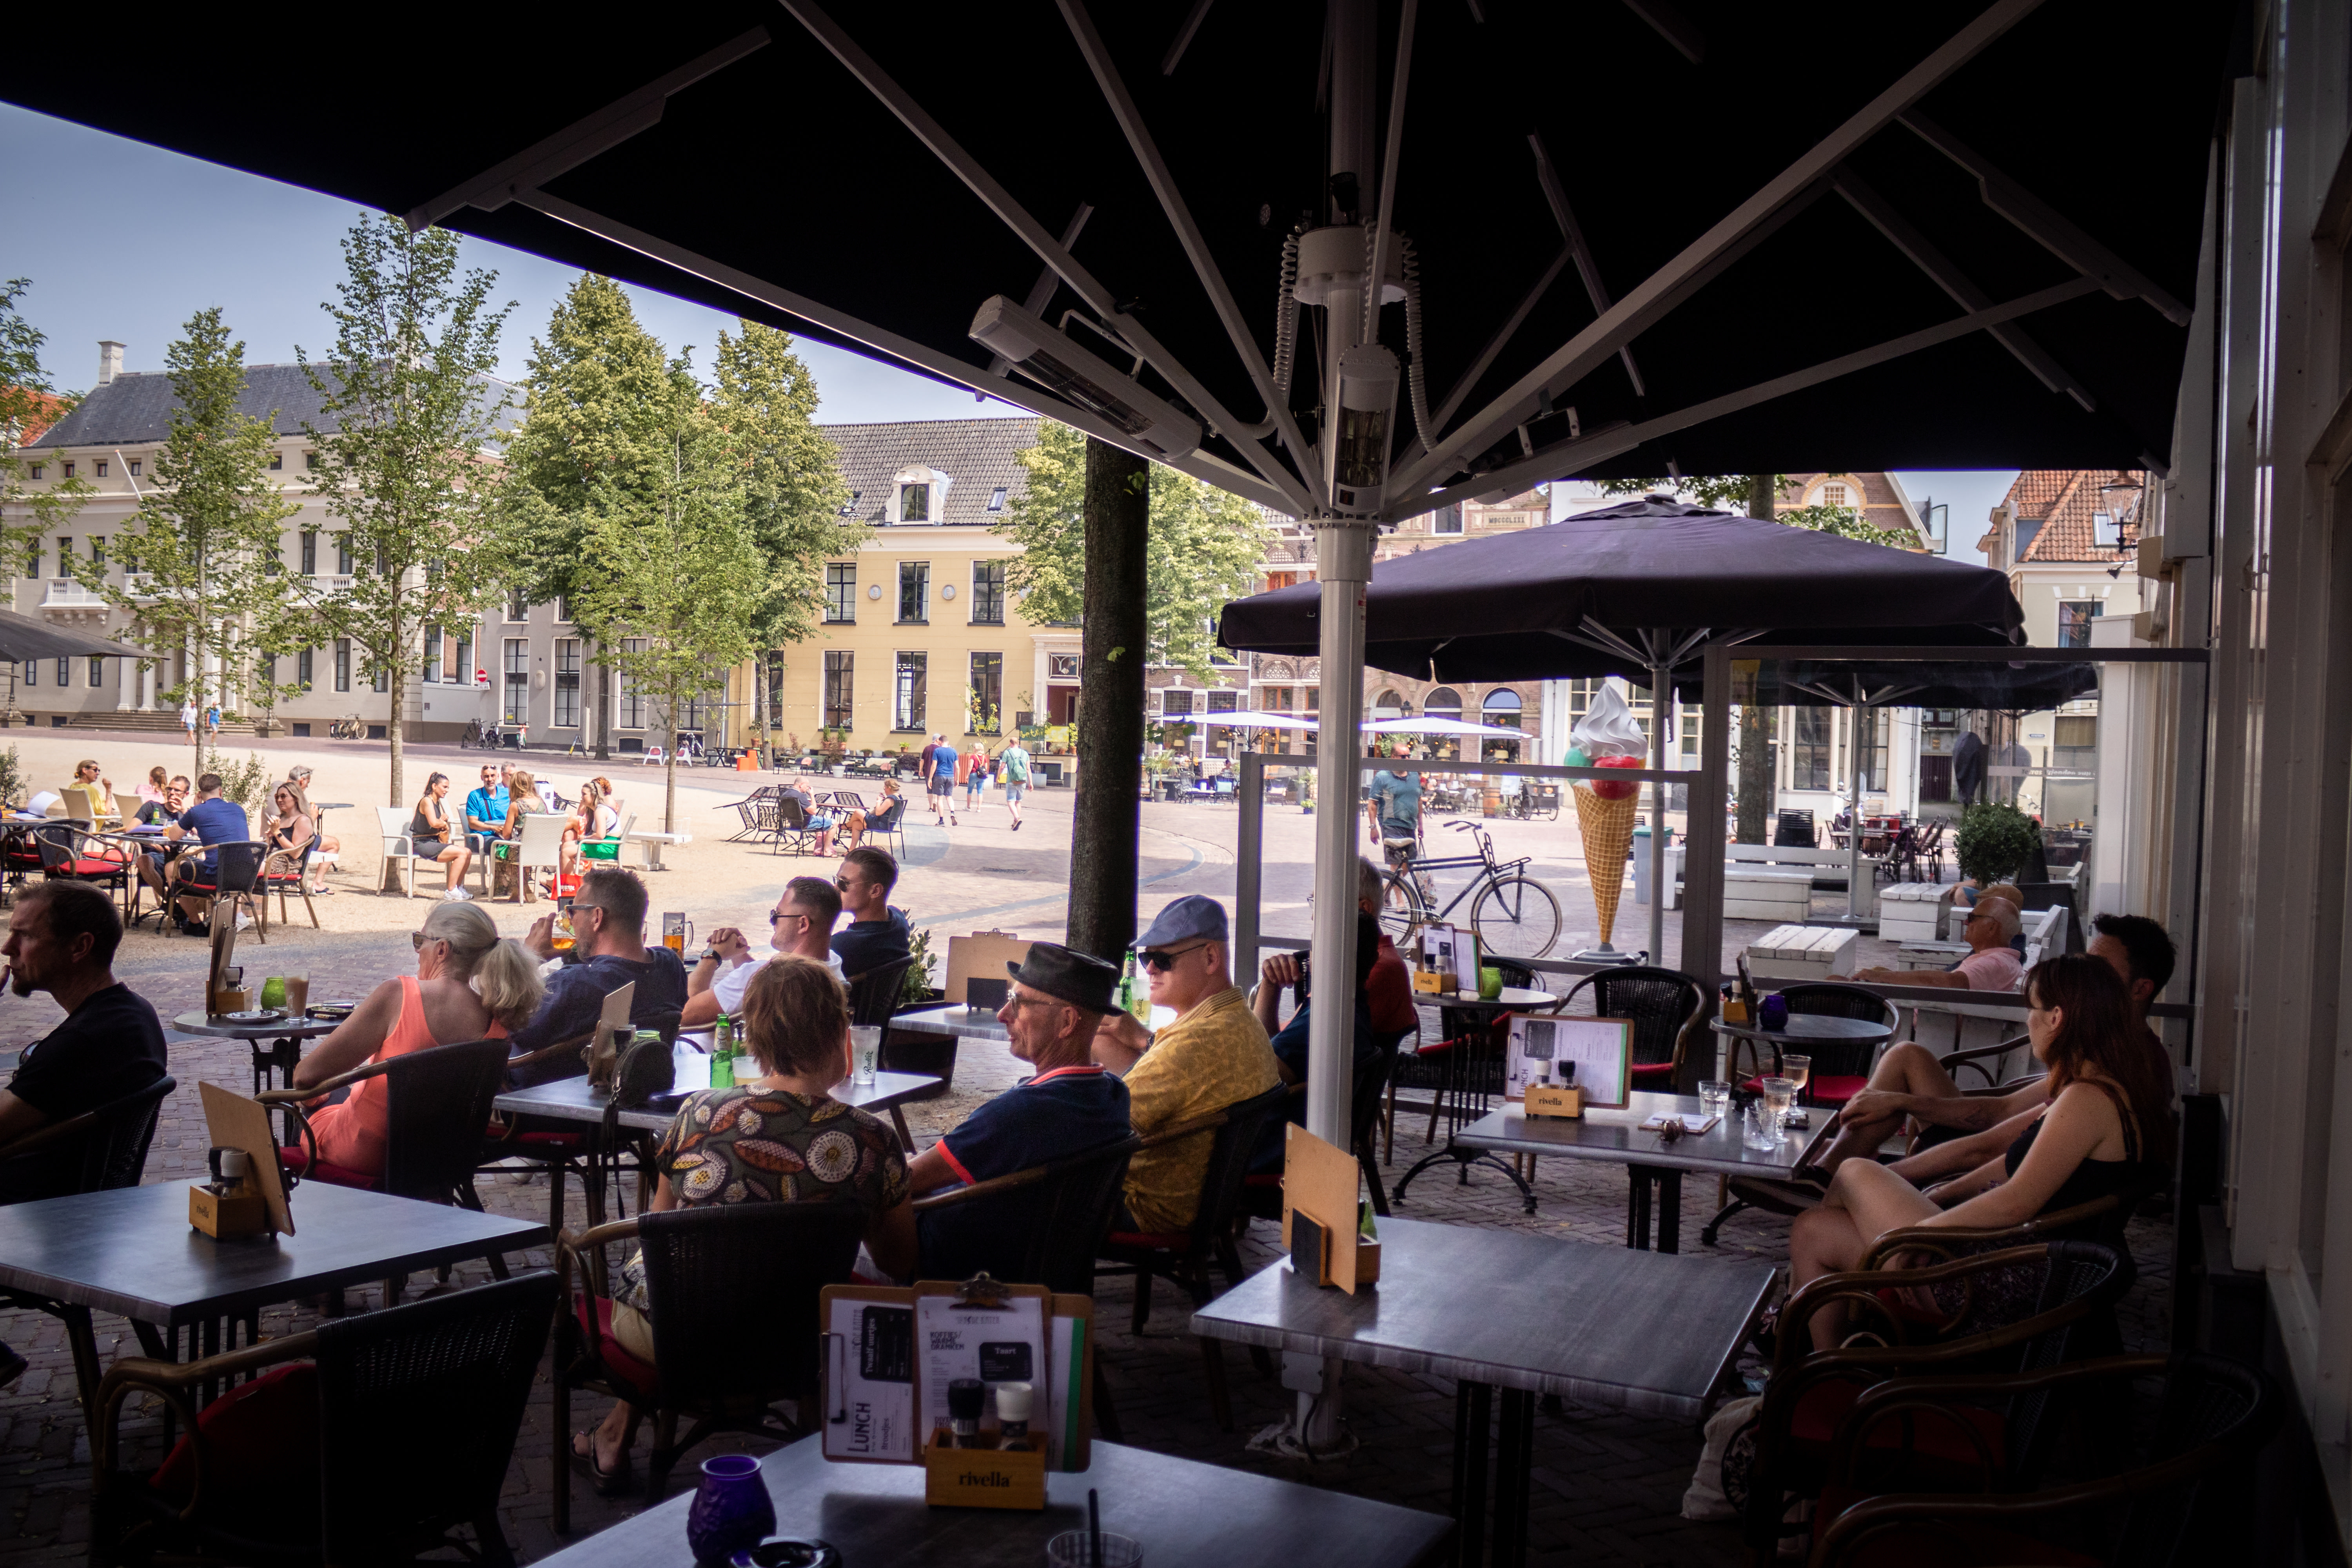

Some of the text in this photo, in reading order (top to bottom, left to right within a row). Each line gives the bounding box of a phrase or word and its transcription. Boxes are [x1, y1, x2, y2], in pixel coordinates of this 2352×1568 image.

[1136, 998, 1144, 1017] Radler
[863, 1051, 873, 1075] Radler
[1538, 1096, 1562, 1106] rivella
[196, 1203, 210, 1219] rivella
[865, 1317, 877, 1373] Twaalf uurtjes
[847, 1402, 871, 1453] LUNCH
[880, 1417, 890, 1450] Broodjes
[959, 1472, 1010, 1488] rivella
